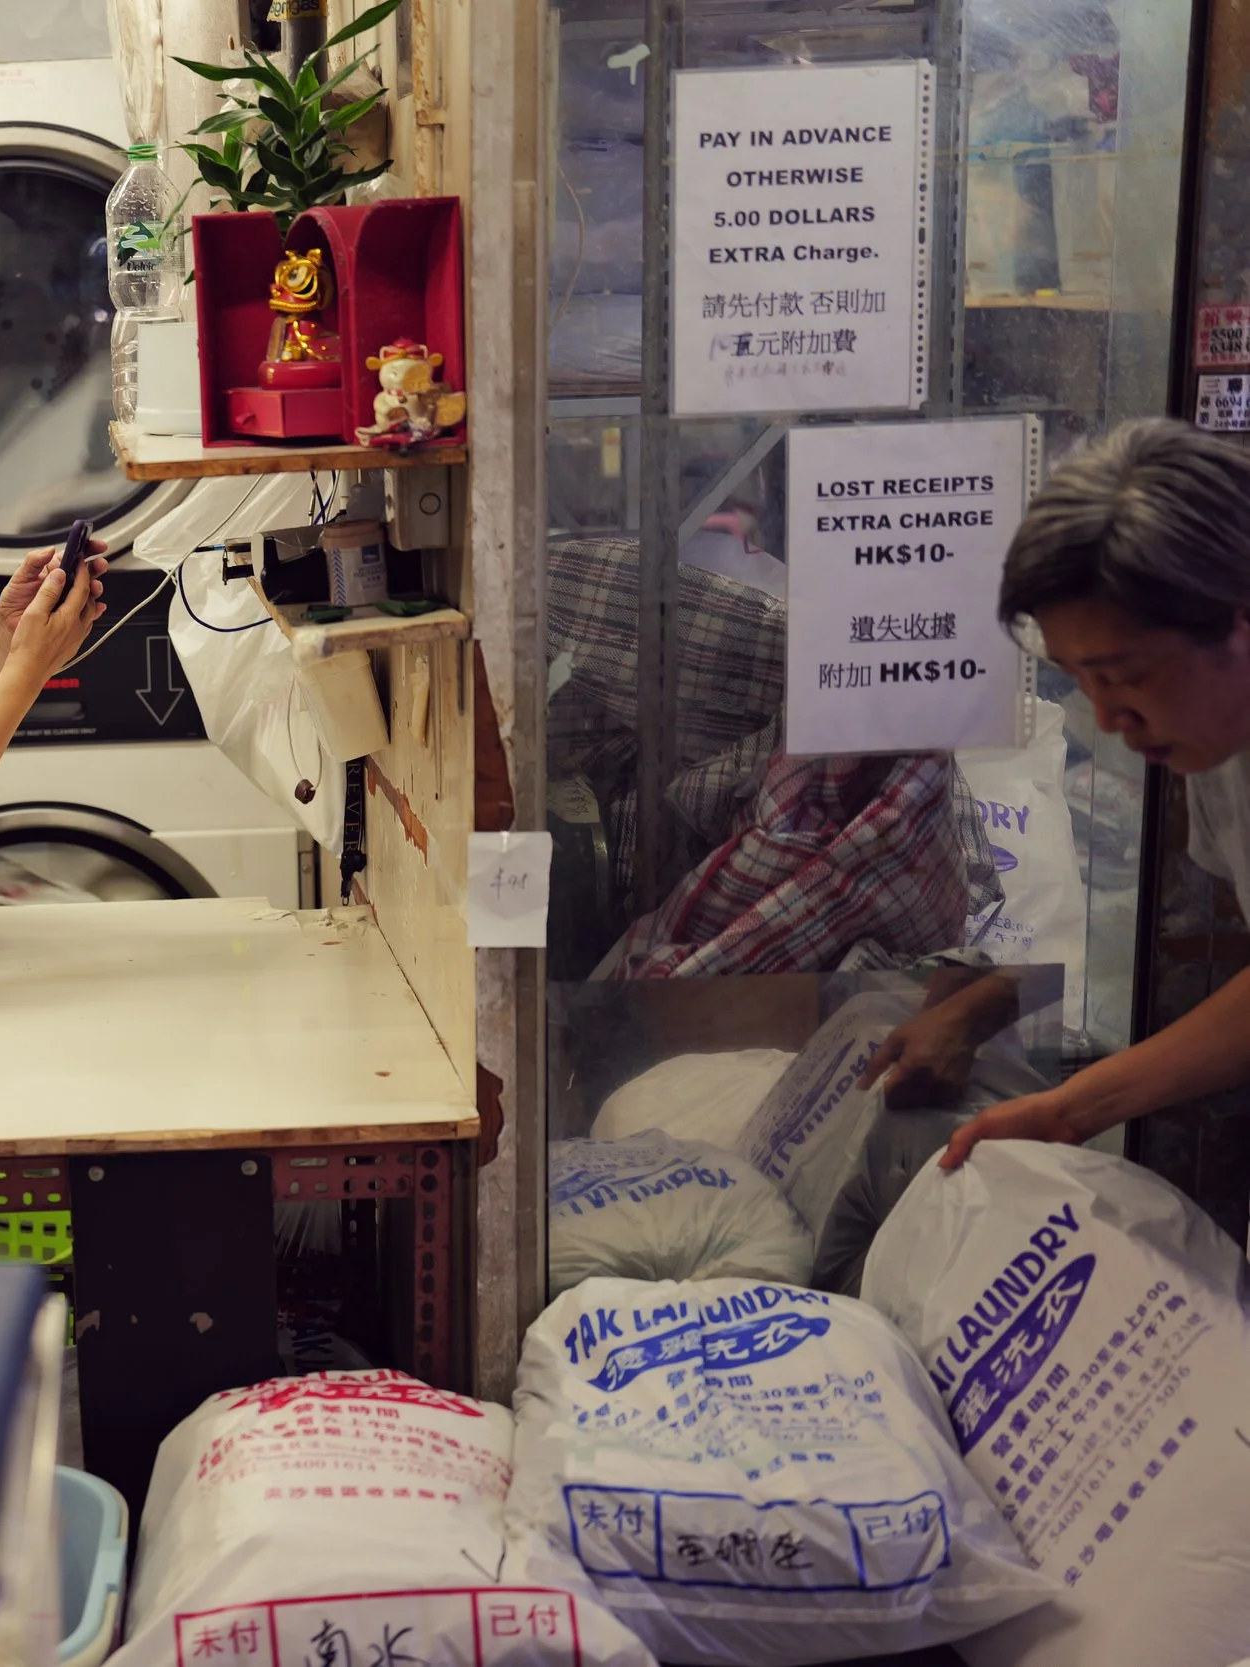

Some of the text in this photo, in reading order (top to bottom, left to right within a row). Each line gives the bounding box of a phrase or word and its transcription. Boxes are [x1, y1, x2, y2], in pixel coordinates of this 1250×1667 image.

[699, 126, 892, 149] PAY IN ADVANCE
[726, 167, 864, 188] OTHERWISE
[714, 206, 876, 227] 5.00 DOLLARS
[708, 244, 879, 265] EXTRA Charge.
[702, 289, 885, 319] 請先付款 否則加
[817, 475, 994, 498] LOST RECEIPTS
[817, 510, 994, 532] EXTRA CHARGE
[855, 543, 954, 565] HK$10-
[850, 612, 957, 641] 遺失收據
[819, 659, 986, 689] 附加 HK$10-
[947, 1203, 1079, 1363] LAUNDRY
[564, 1308, 624, 1365] TAK
[581, 1502, 644, 1537] 未付
[193, 1617, 261, 1659] 未付
